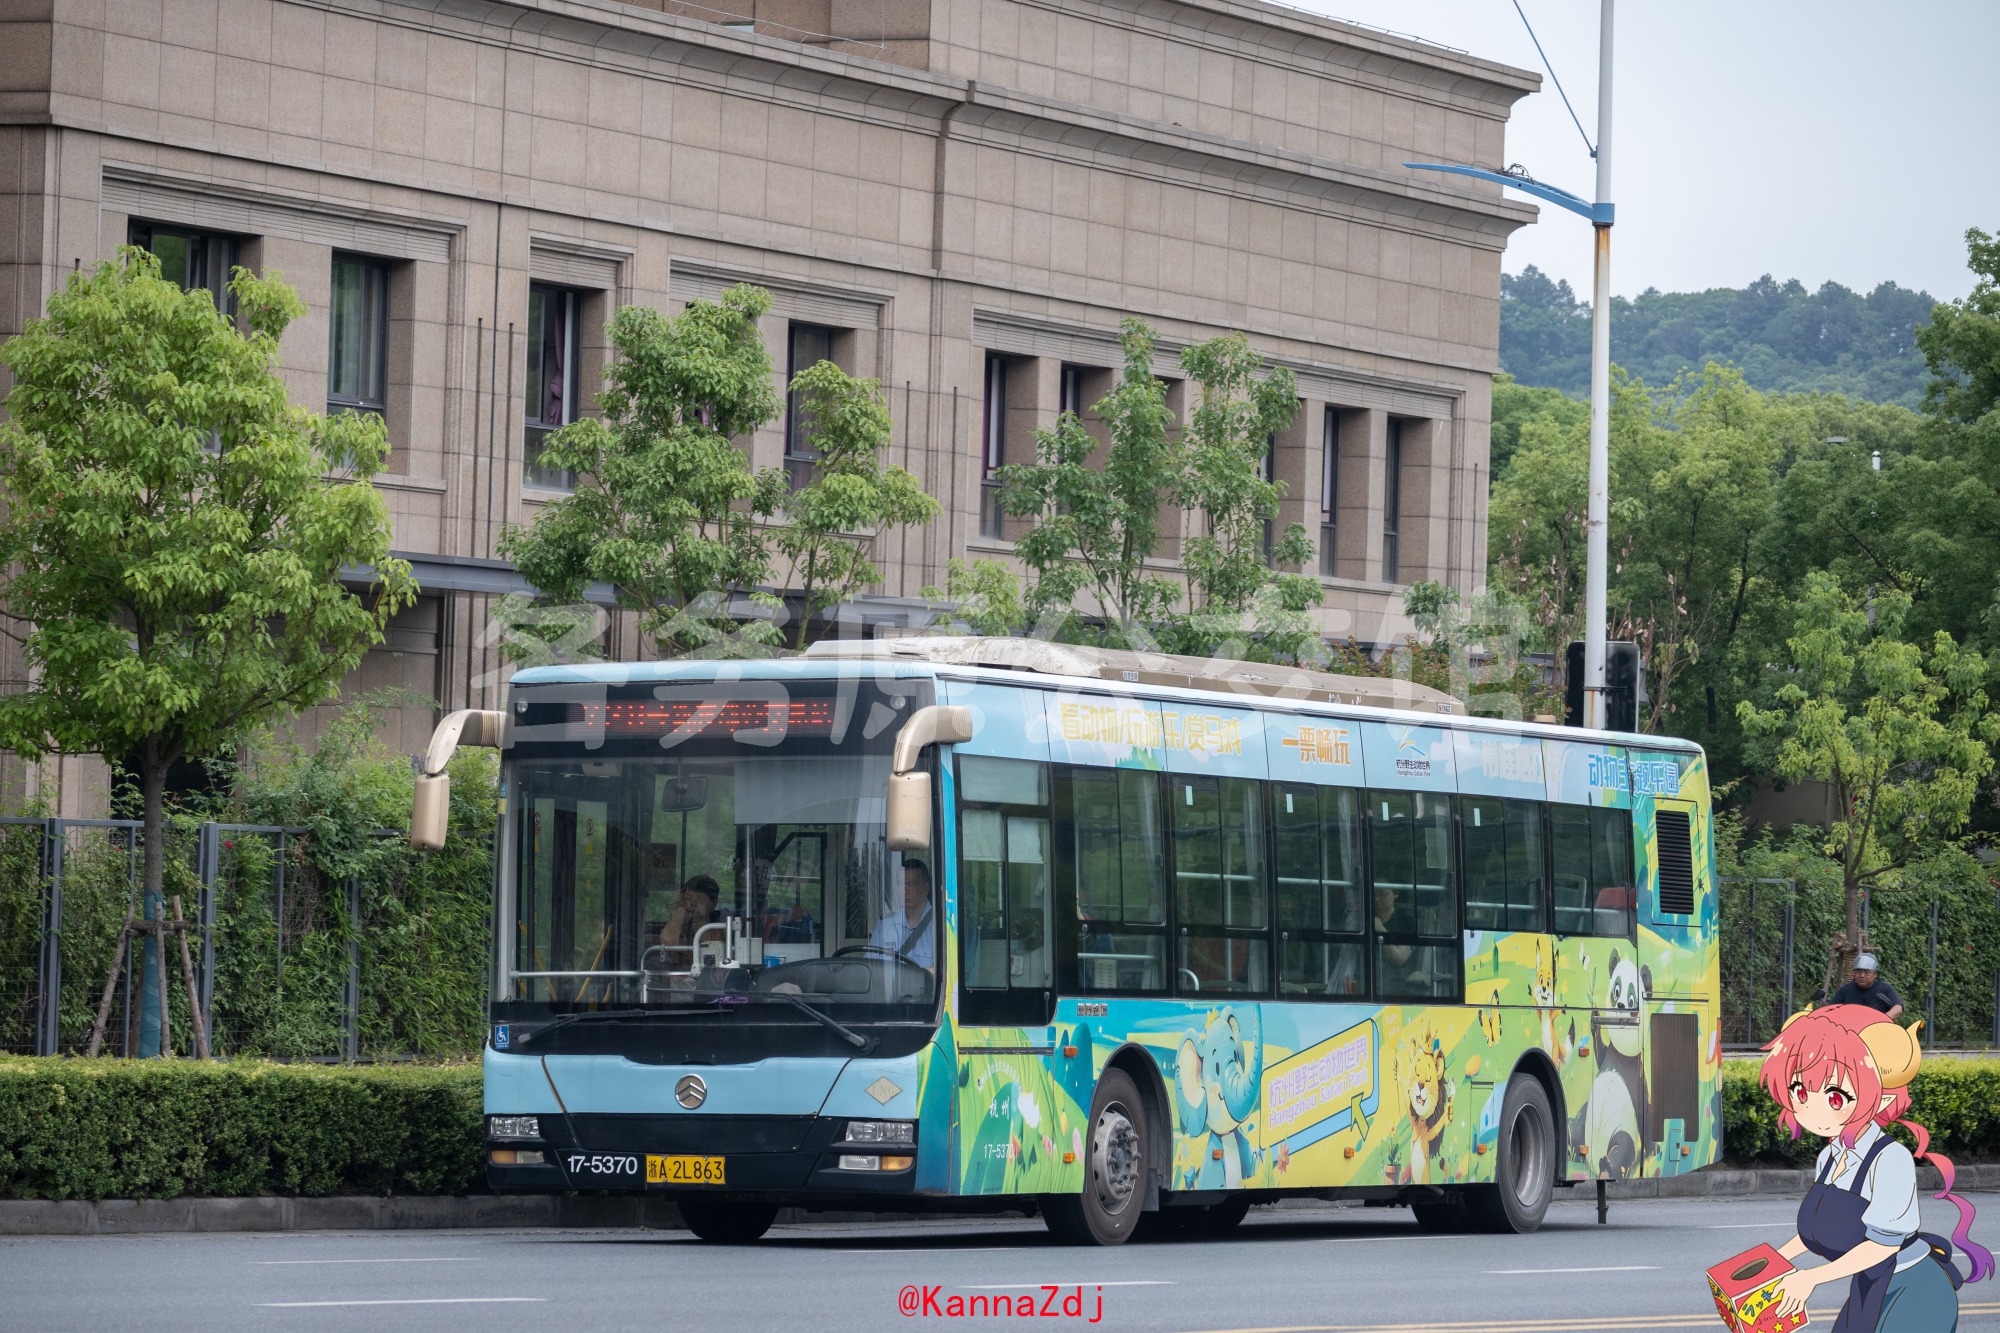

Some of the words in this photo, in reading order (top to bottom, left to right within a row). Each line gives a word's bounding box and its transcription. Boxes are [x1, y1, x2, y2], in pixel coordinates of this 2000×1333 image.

[1282, 725, 1351, 766] 一票畅玩
[1588, 753, 1680, 795] 动物主题乐园
[1268, 1036, 1368, 1109] 杭州野生动物世界
[990, 1096, 1010, 1120] 杭州
[1269, 1093, 1317, 1129] Hangzhou
[1320, 1076, 1347, 1104] Safari
[1348, 1067, 1368, 1090] Park
[567, 1155, 638, 1175] 17-5370
[984, 1144, 1015, 1159] 17-5370
